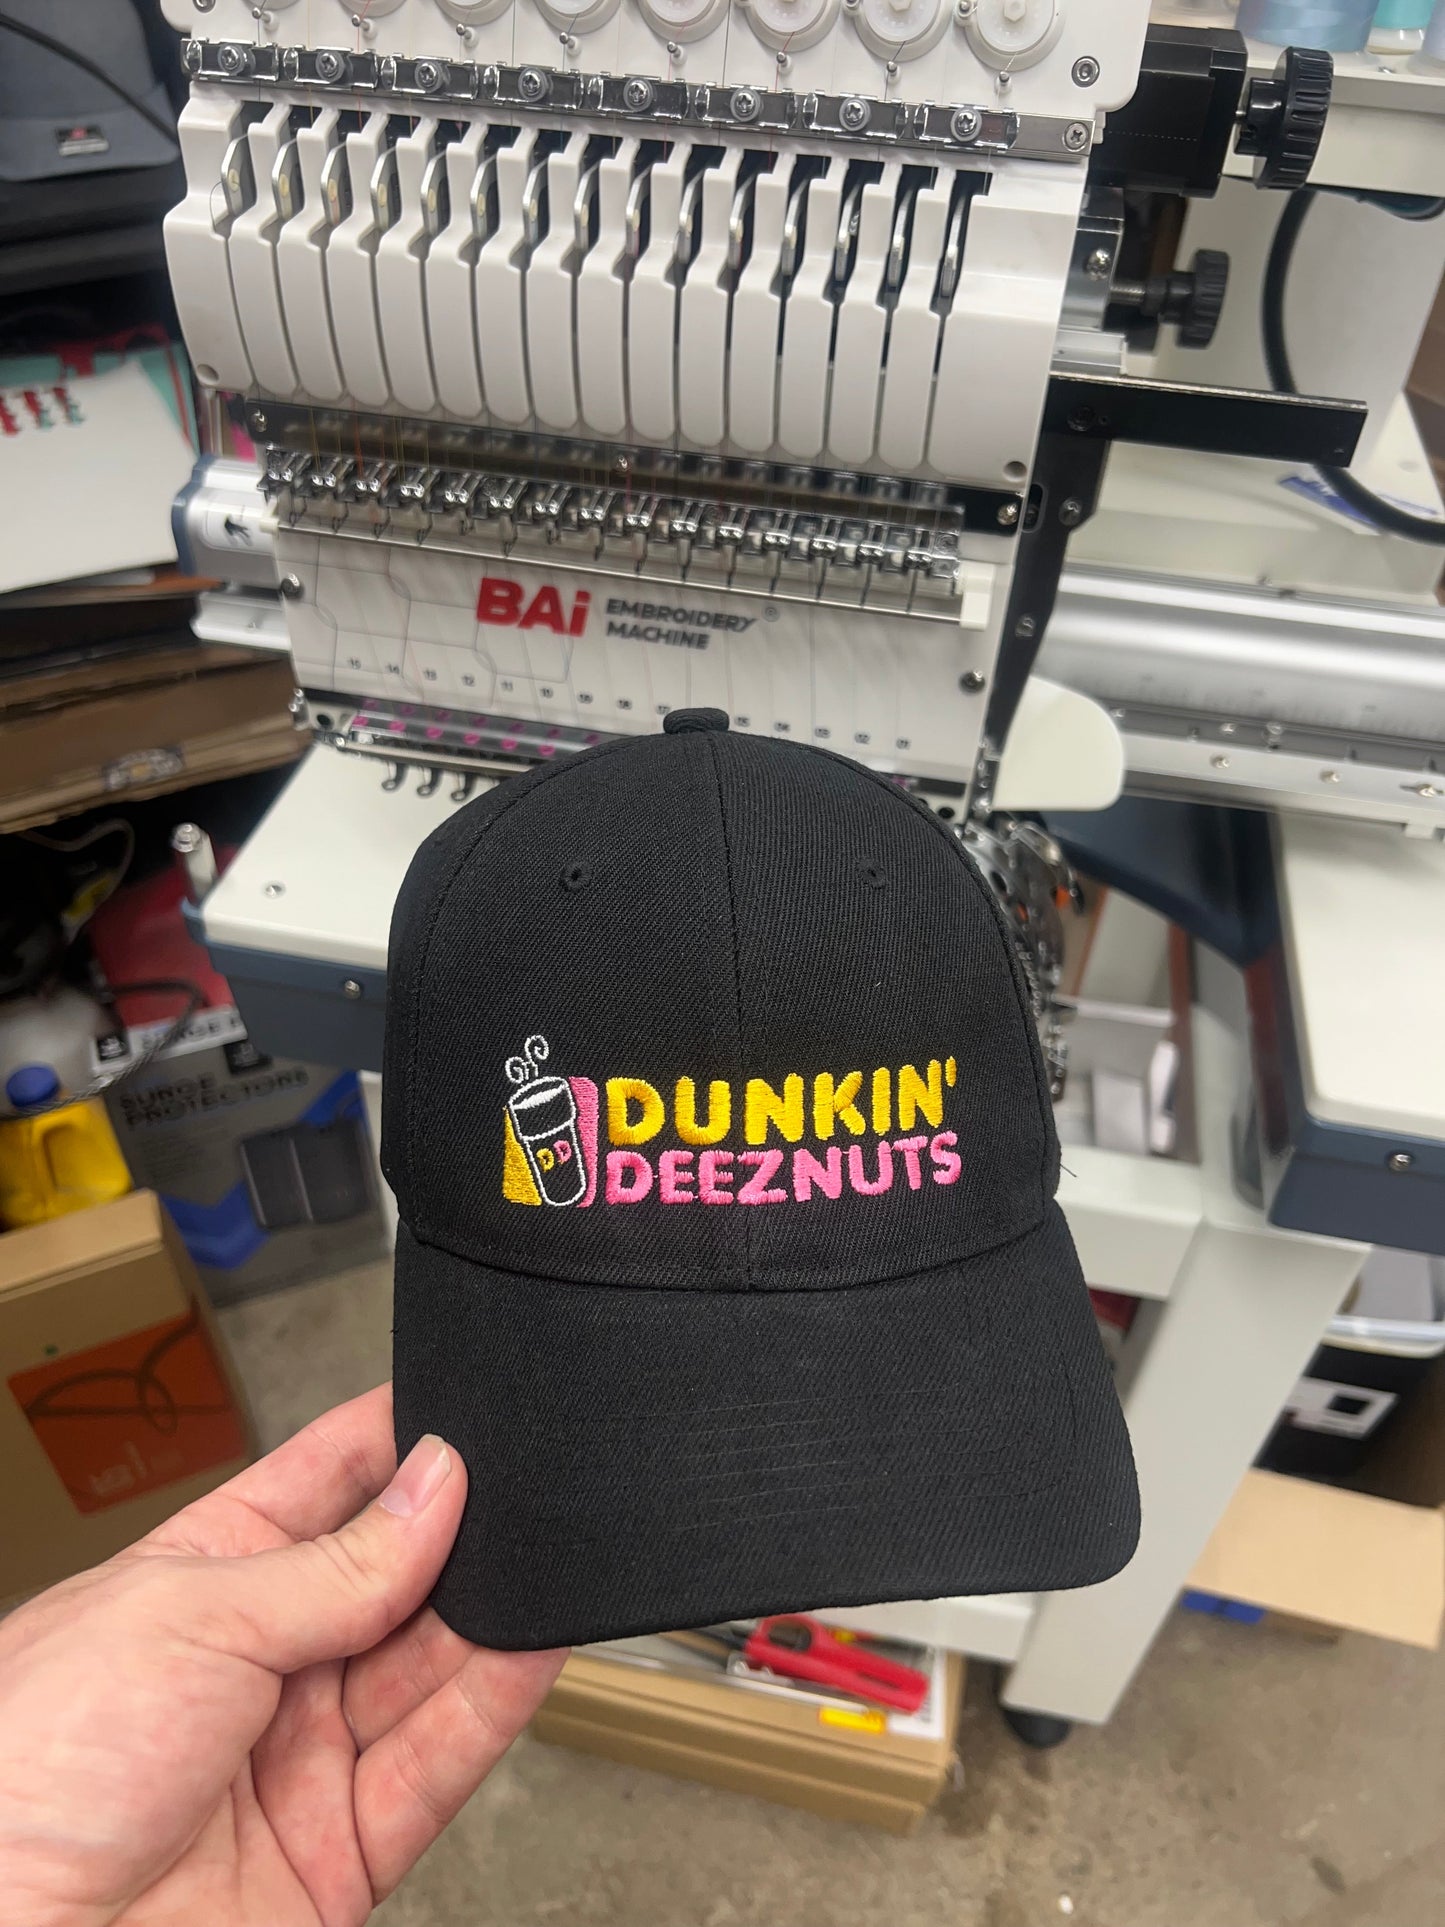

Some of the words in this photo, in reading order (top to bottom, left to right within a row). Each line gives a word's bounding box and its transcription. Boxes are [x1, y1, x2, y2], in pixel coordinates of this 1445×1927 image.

[476, 577, 592, 637] BAi
[606, 598, 757, 633] EMBROIDERY
[606, 620, 711, 650] MACHINE
[605, 1056, 957, 1146] DUNKIN'
[606, 1131, 961, 1205] DEEZNUTS
